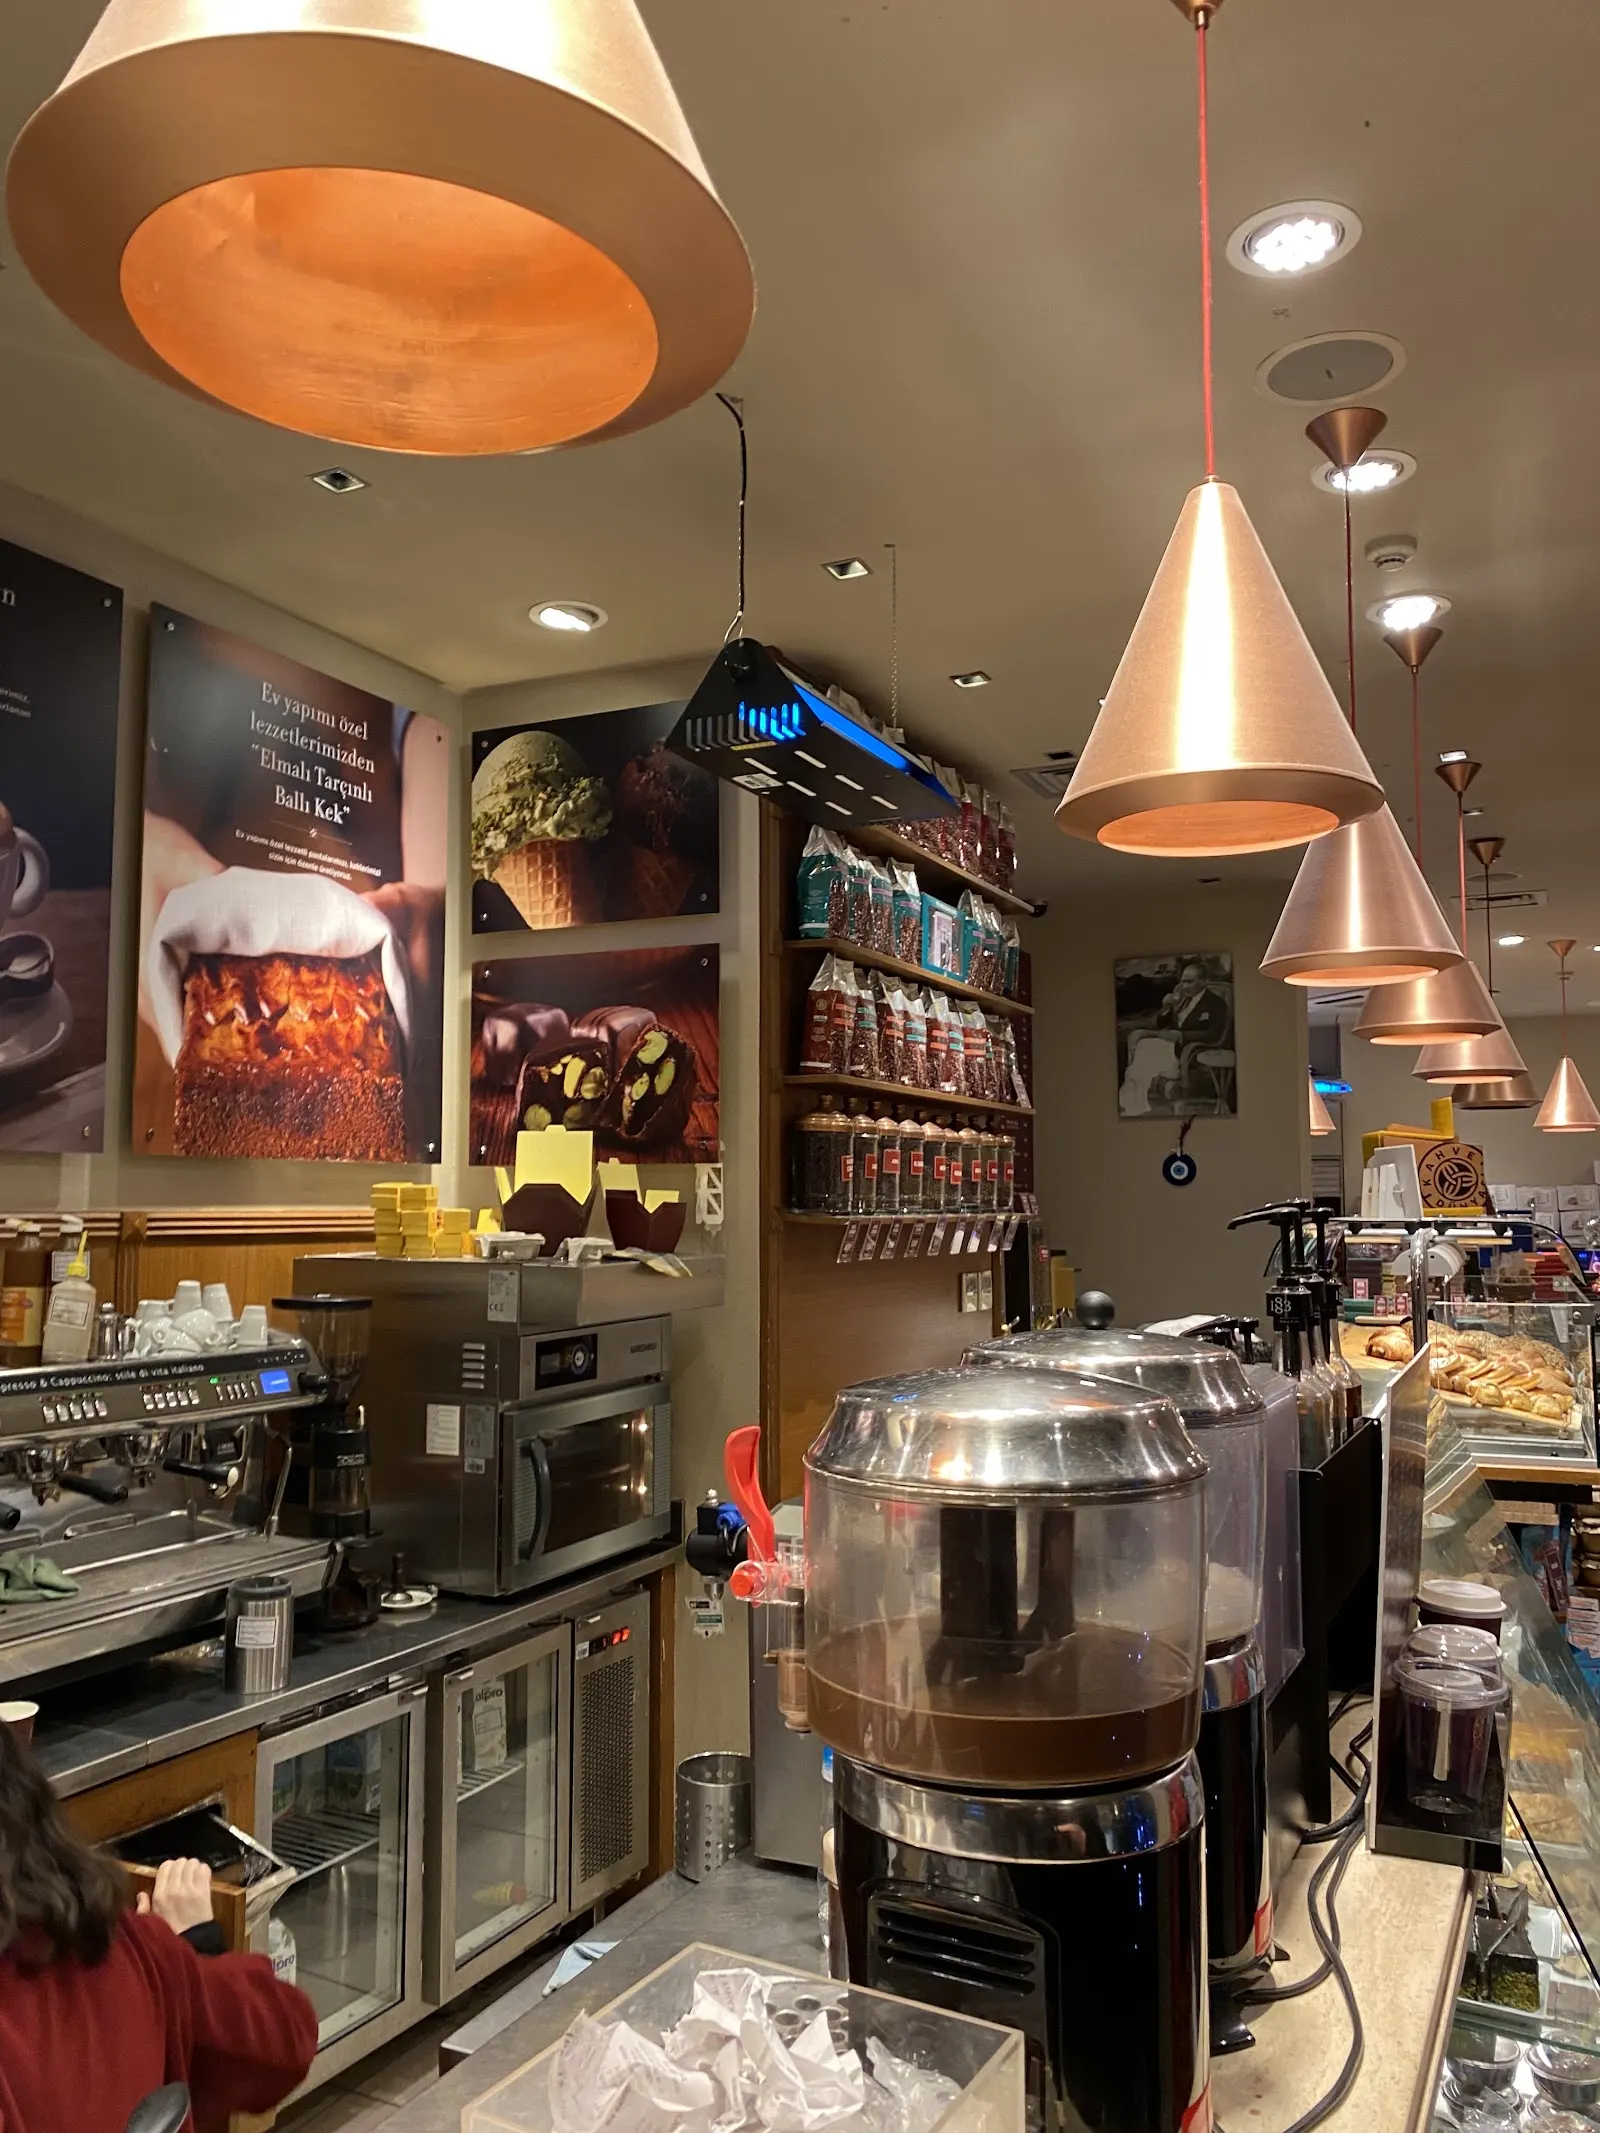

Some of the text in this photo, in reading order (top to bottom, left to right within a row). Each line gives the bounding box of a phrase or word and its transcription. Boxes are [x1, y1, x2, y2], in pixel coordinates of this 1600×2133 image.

[261, 681, 368, 741] Ev yapımı özel
[250, 710, 376, 774] lezzetlerimizden
[274, 784, 311, 814] Ballı
[314, 765, 373, 804] Tarçınlı
[1423, 1146, 1476, 1187] KAHVE
[0, 1382, 37, 1393] presso
[39, 1378, 48, 1389] &
[474, 1686, 504, 1703] alpro
[272, 1954, 295, 1972] lpro
